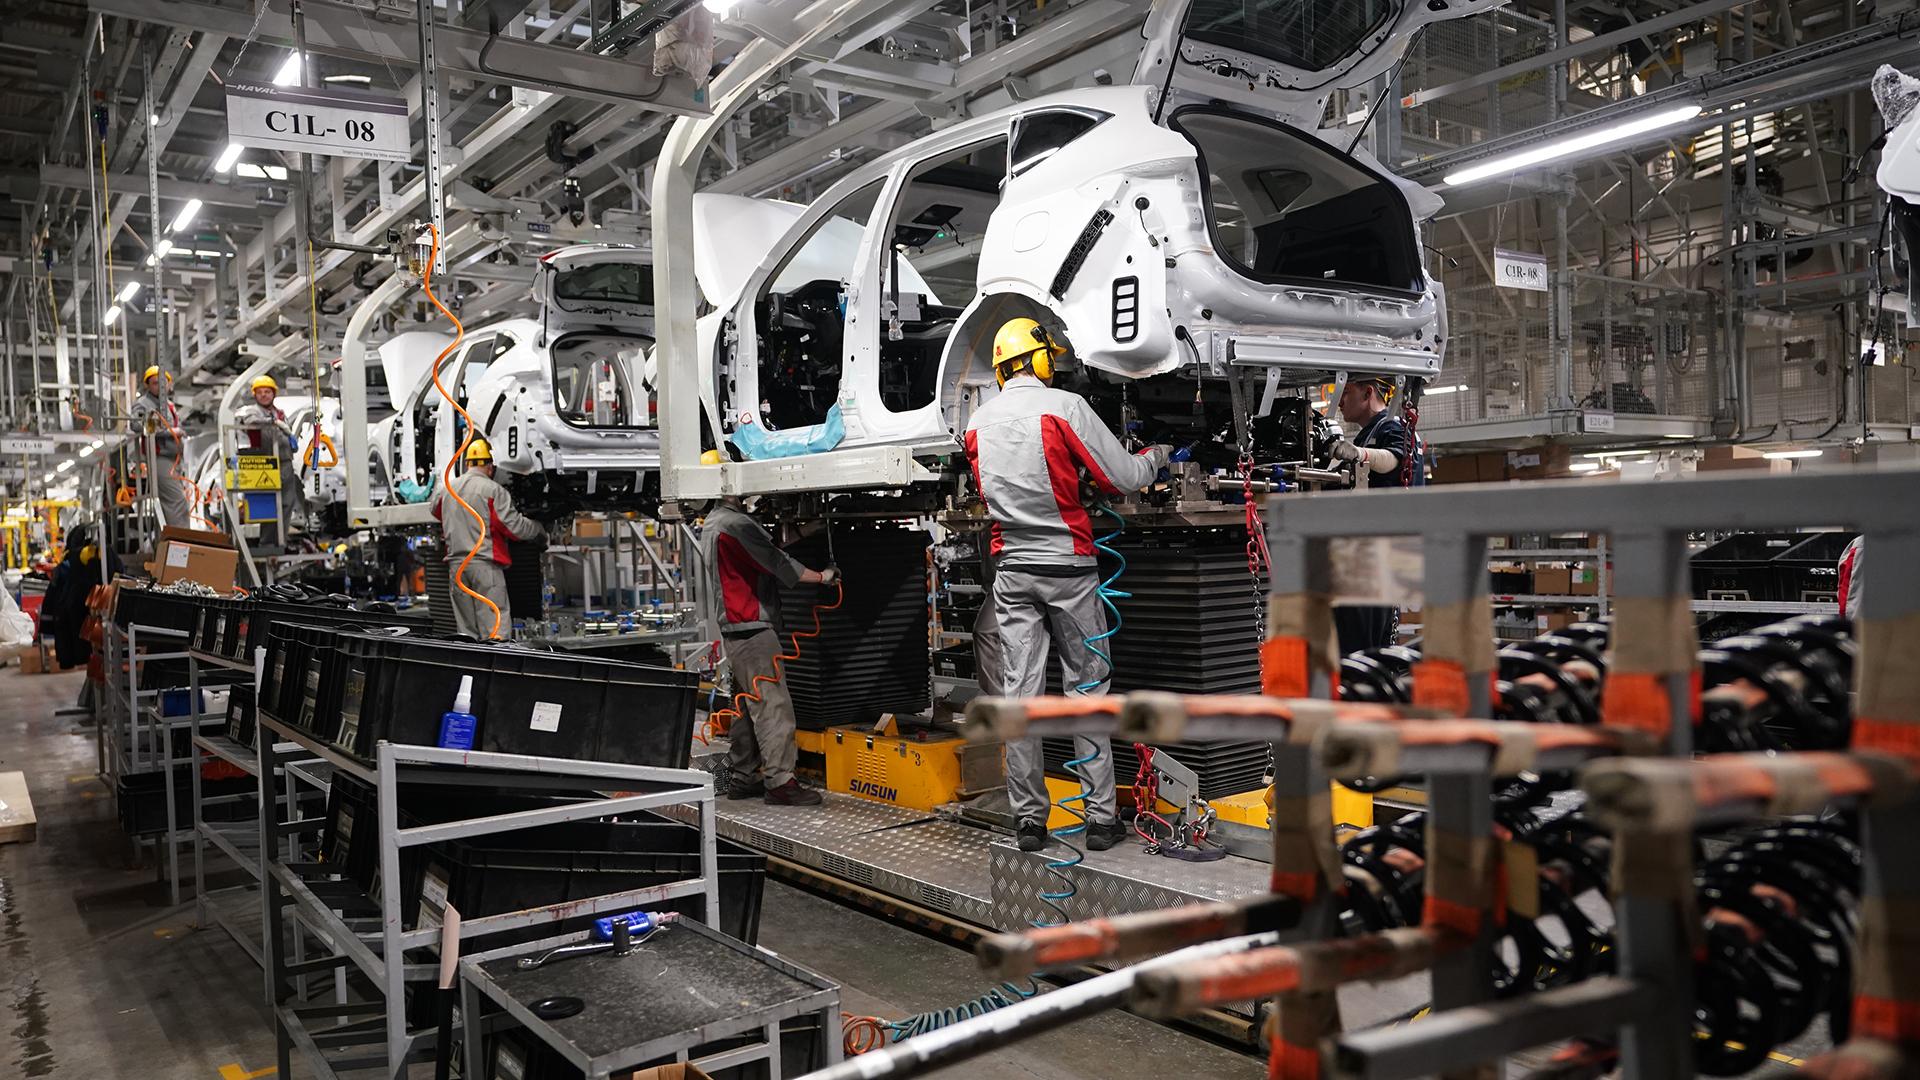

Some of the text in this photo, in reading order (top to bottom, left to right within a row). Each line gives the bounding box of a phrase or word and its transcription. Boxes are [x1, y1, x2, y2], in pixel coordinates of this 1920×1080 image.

[236, 83, 278, 95] HAVAL
[265, 110, 375, 142] C1L- 08
[849, 778, 898, 802] SIASUN
